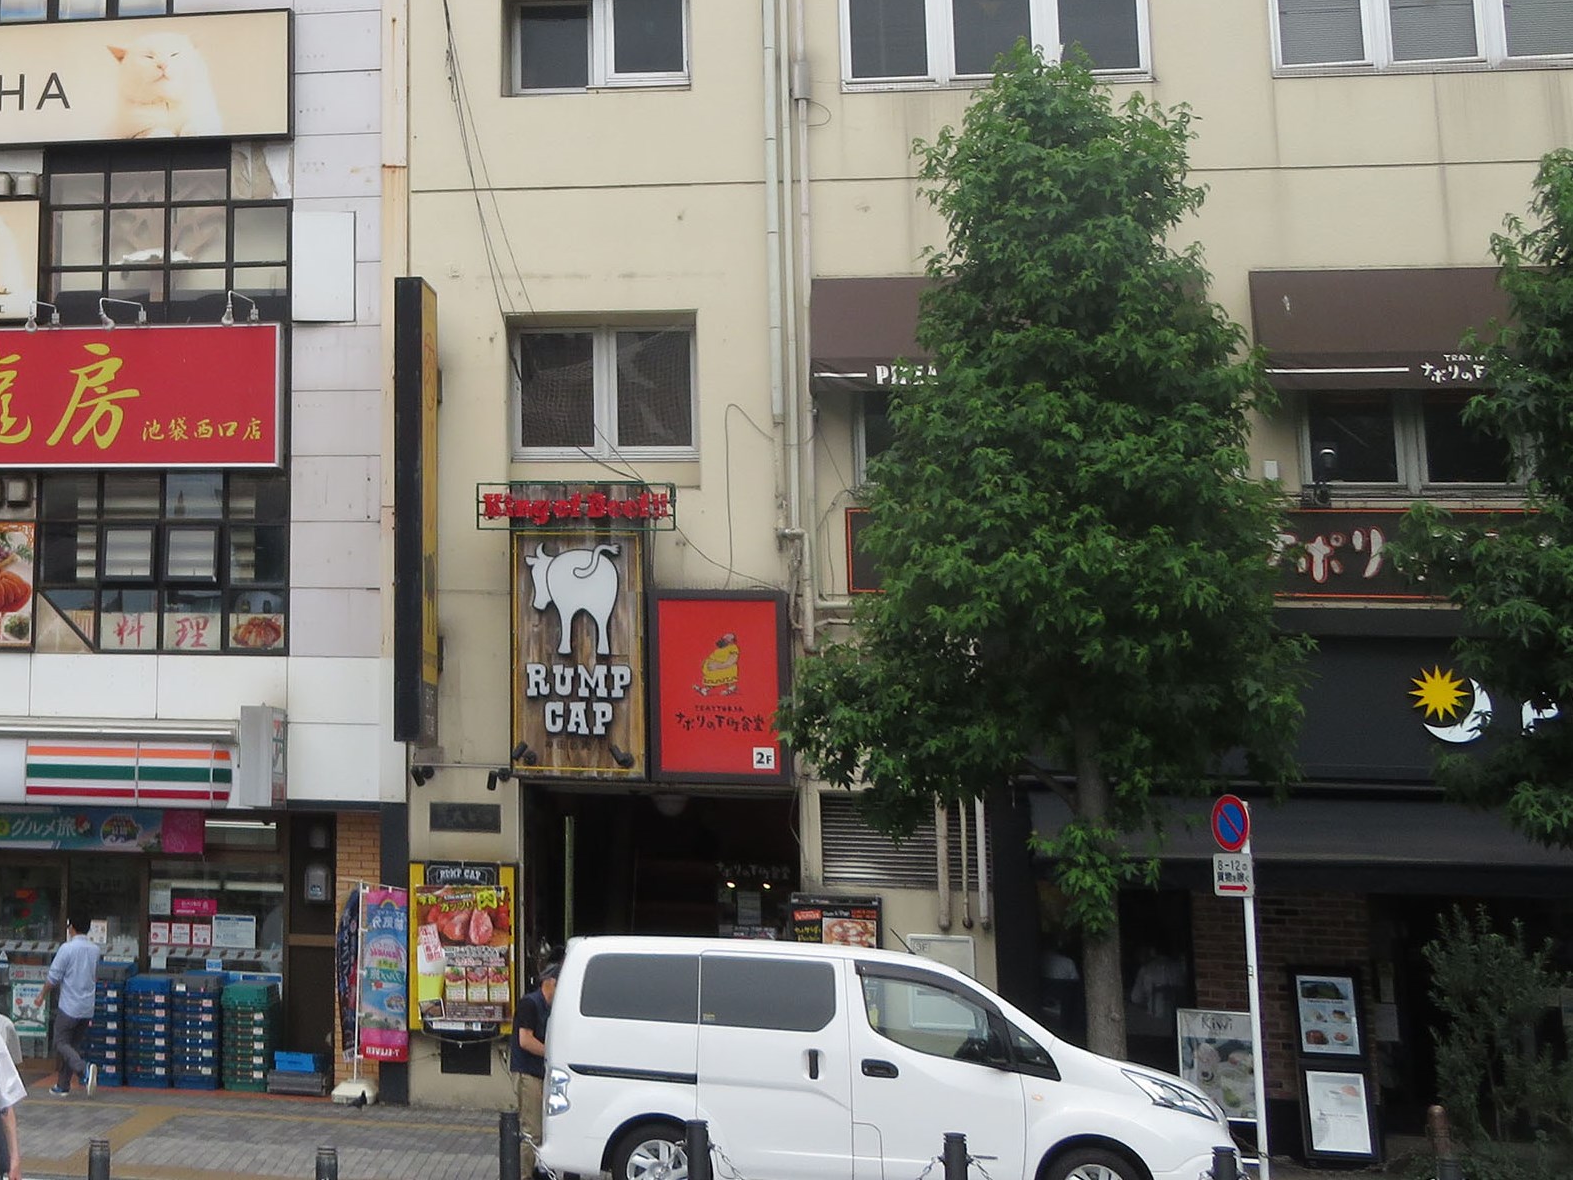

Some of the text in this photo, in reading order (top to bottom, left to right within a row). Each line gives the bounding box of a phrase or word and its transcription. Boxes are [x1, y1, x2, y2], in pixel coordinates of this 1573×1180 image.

[141, 416, 263, 443] 池袋西口店
[113, 612, 211, 650] 料理
[526, 663, 632, 698] RUMP
[545, 701, 613, 736] CAP
[675, 713, 766, 732] ナポリの下町食堂
[756, 752, 773, 765] 2F
[464, 869, 481, 880] CAP
